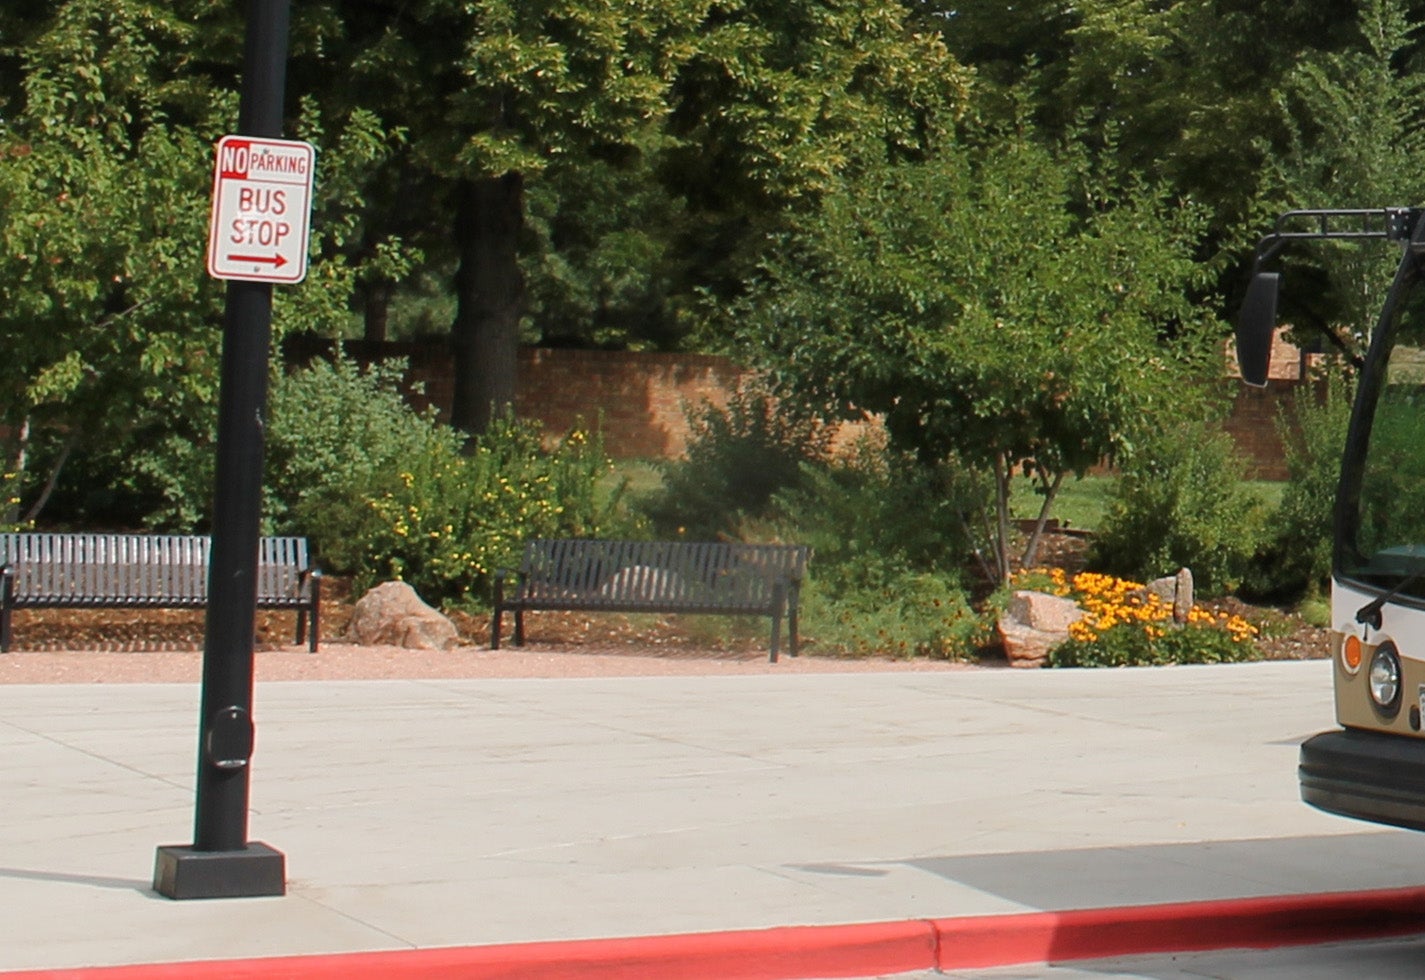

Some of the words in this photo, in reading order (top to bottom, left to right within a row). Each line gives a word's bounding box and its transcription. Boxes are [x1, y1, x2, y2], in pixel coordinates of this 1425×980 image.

[222, 146, 248, 173] NO
[251, 153, 306, 174] PARKING
[239, 187, 286, 215] BUS
[231, 218, 290, 247] STOP
